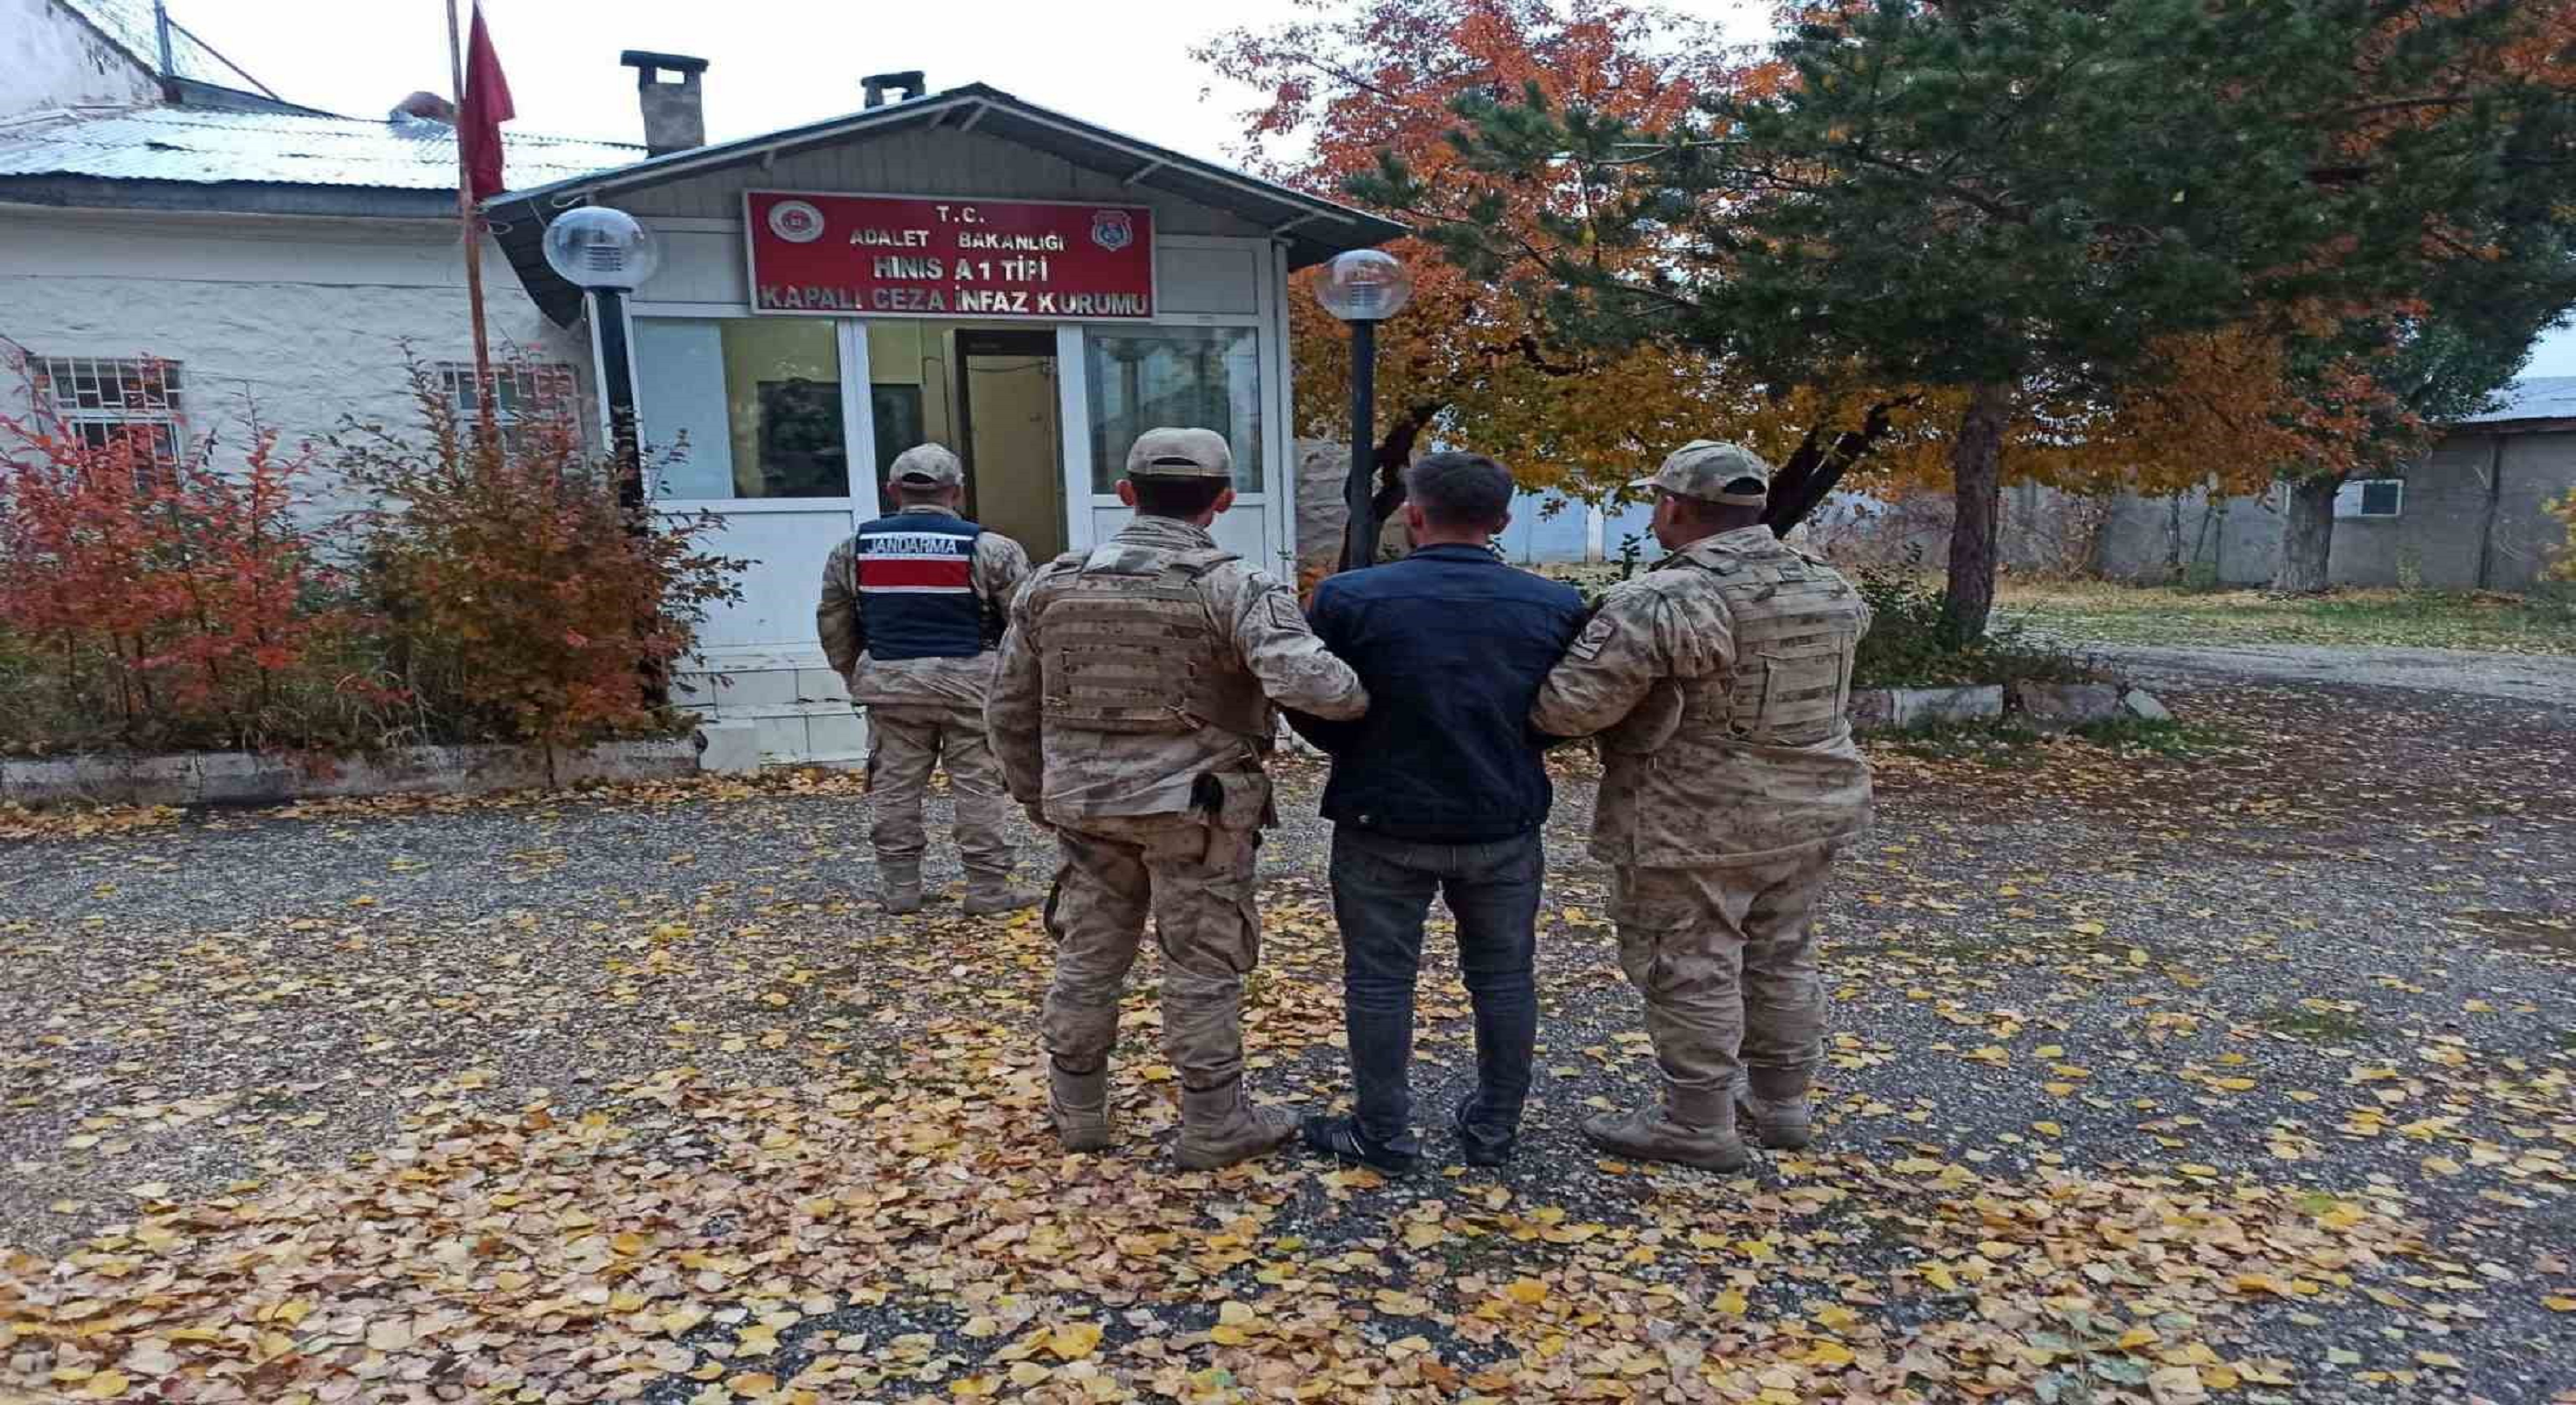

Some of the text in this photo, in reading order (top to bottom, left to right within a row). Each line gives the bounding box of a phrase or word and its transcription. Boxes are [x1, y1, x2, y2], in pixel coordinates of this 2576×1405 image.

[936, 206, 984, 223] T.C.
[850, 229, 929, 247] ADALET
[874, 256, 944, 280] HINIS
[1002, 254, 1047, 282] TİPİ
[760, 284, 1147, 315] KAPALI CEZA İNFAZ KURUMU
[867, 535, 958, 554] JANDARMA
